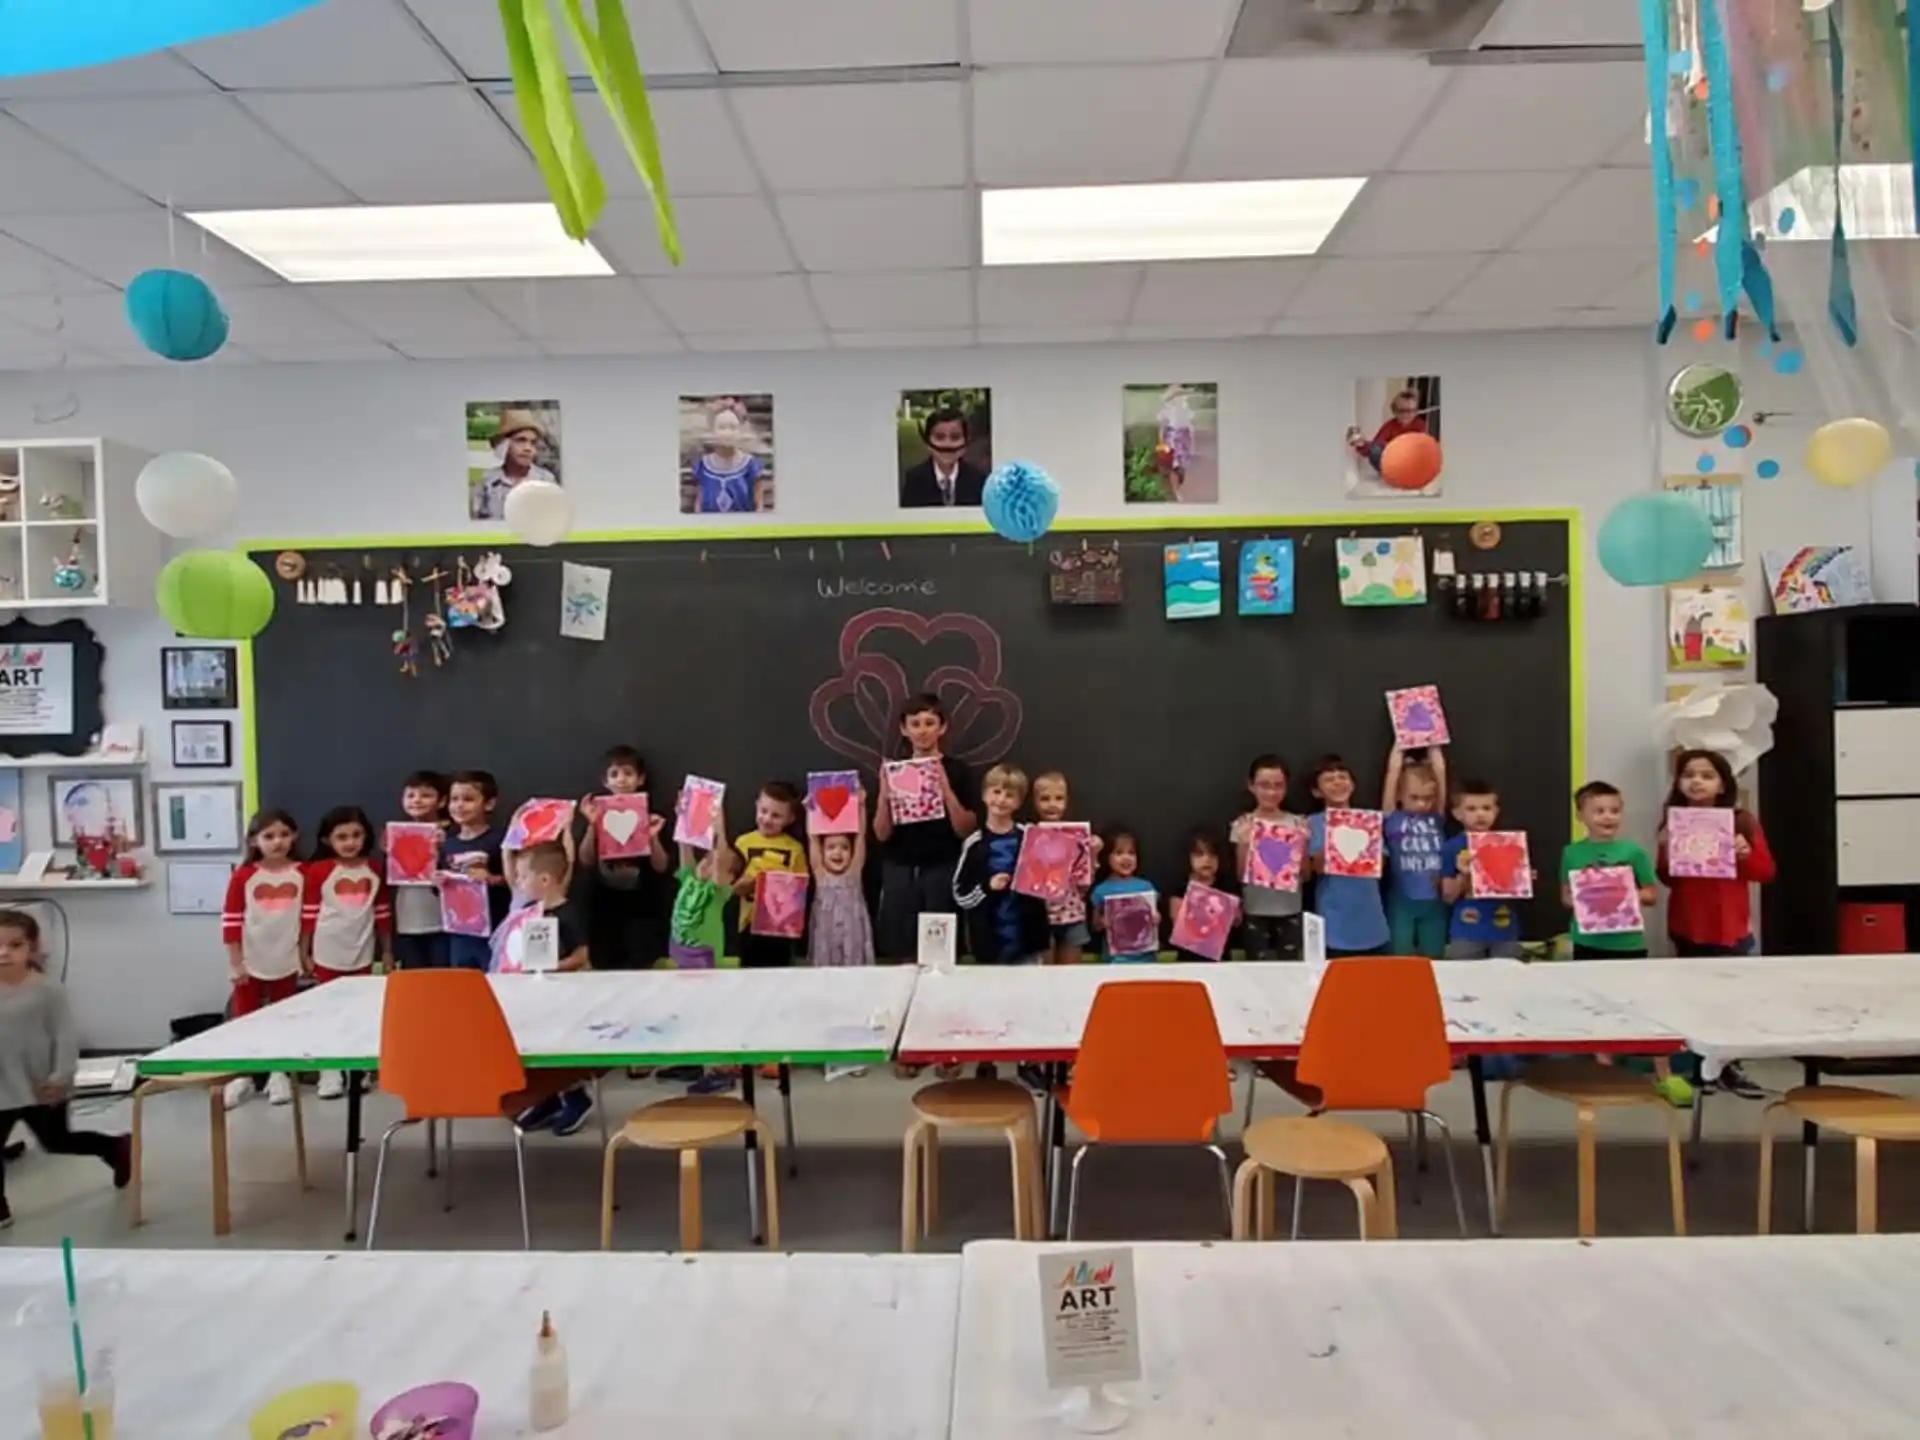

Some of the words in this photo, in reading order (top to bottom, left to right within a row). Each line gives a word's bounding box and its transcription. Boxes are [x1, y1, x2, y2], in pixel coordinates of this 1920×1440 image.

[817, 576, 939, 599] Welcome
[0, 667, 44, 686] ART
[1060, 1286, 1117, 1311] ART
